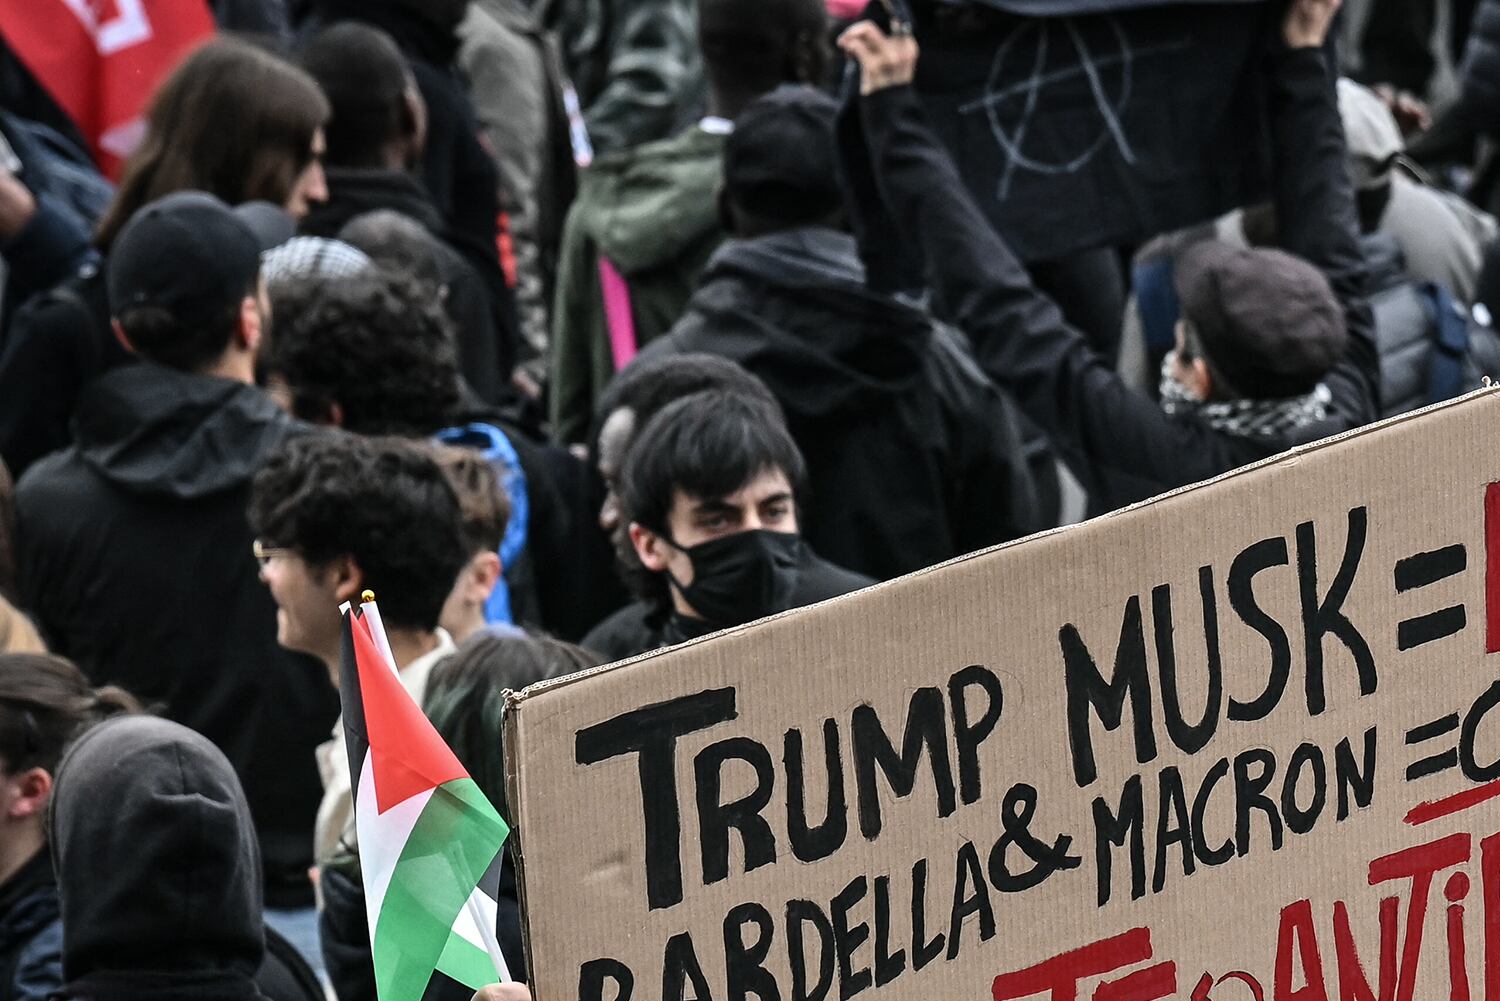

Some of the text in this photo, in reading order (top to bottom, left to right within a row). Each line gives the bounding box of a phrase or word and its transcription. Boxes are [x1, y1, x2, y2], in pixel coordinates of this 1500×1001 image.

[575, 664, 1004, 912] TRUMP
[1059, 505, 1378, 788] MUSK
[988, 782, 1083, 893] &
[1091, 725, 1377, 908] MACRON
